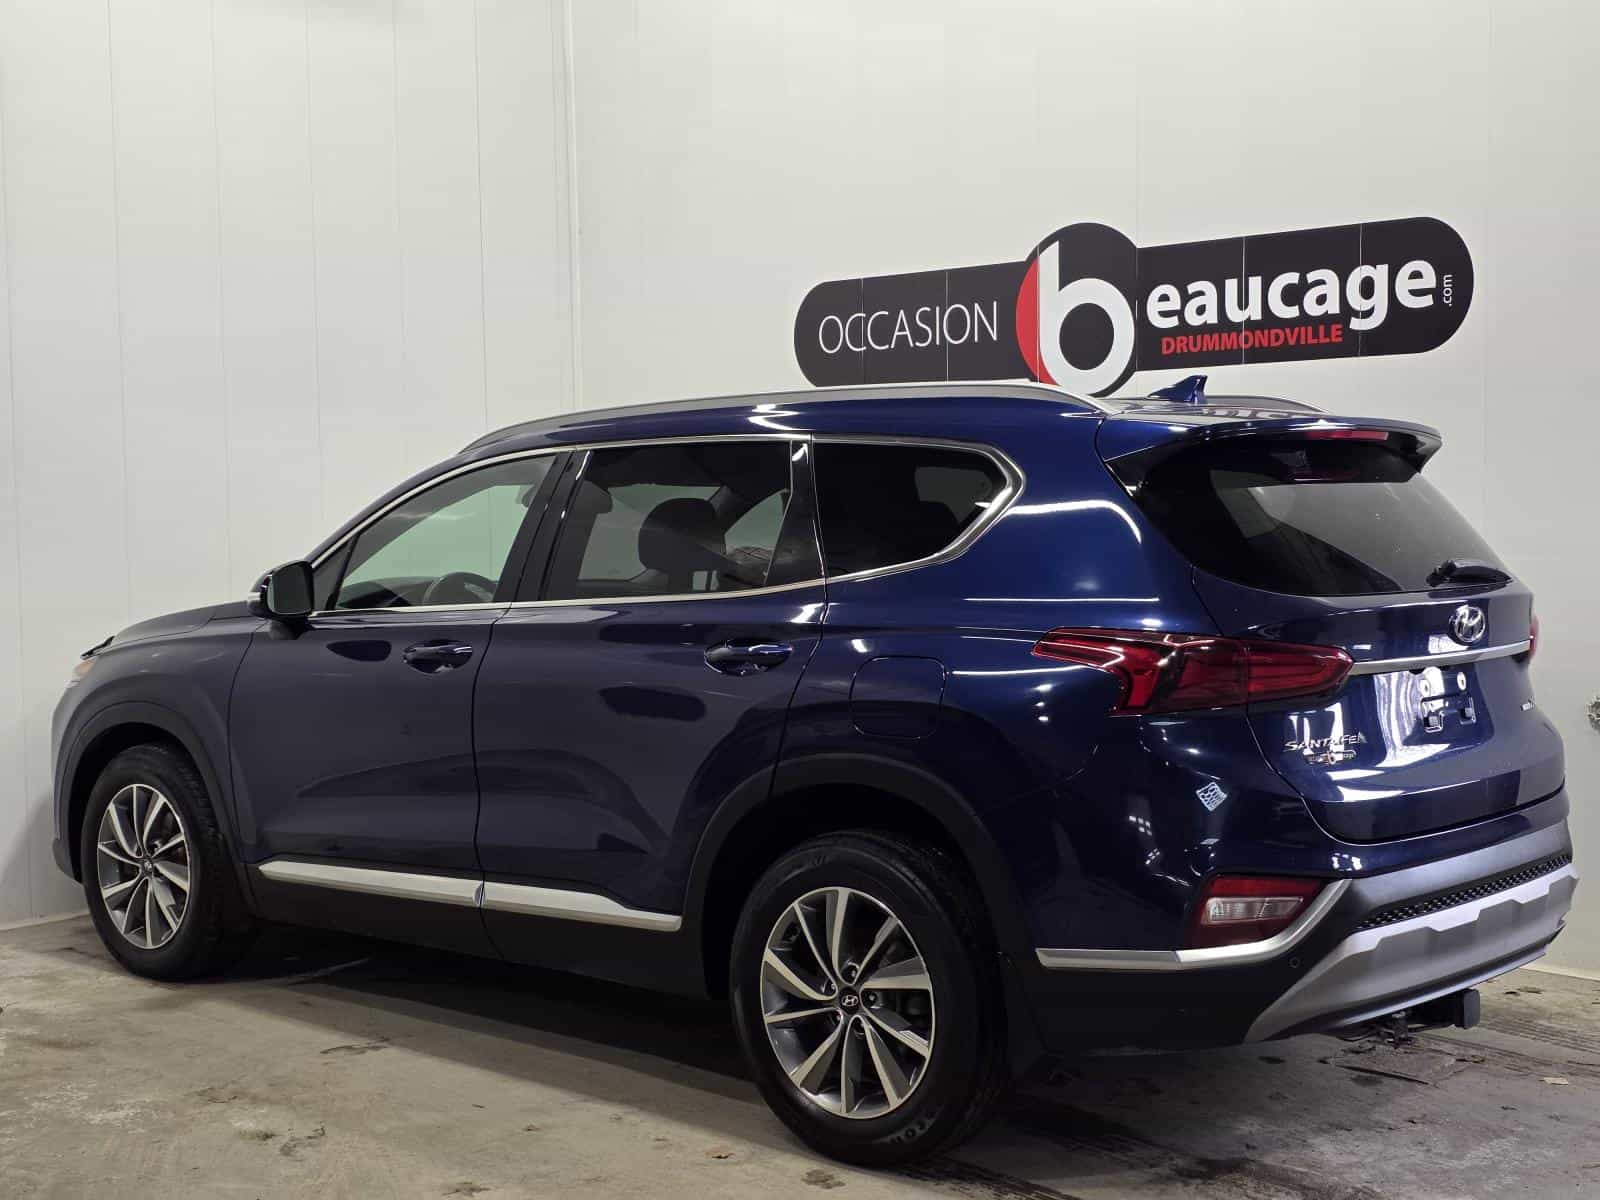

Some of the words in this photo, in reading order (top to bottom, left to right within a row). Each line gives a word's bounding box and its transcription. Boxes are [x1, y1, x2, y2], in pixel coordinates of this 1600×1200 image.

[1438, 273, 1453, 307] .com
[818, 300, 998, 354] OCCASION
[1161, 324, 1343, 355] DRUMMONDVILLE
